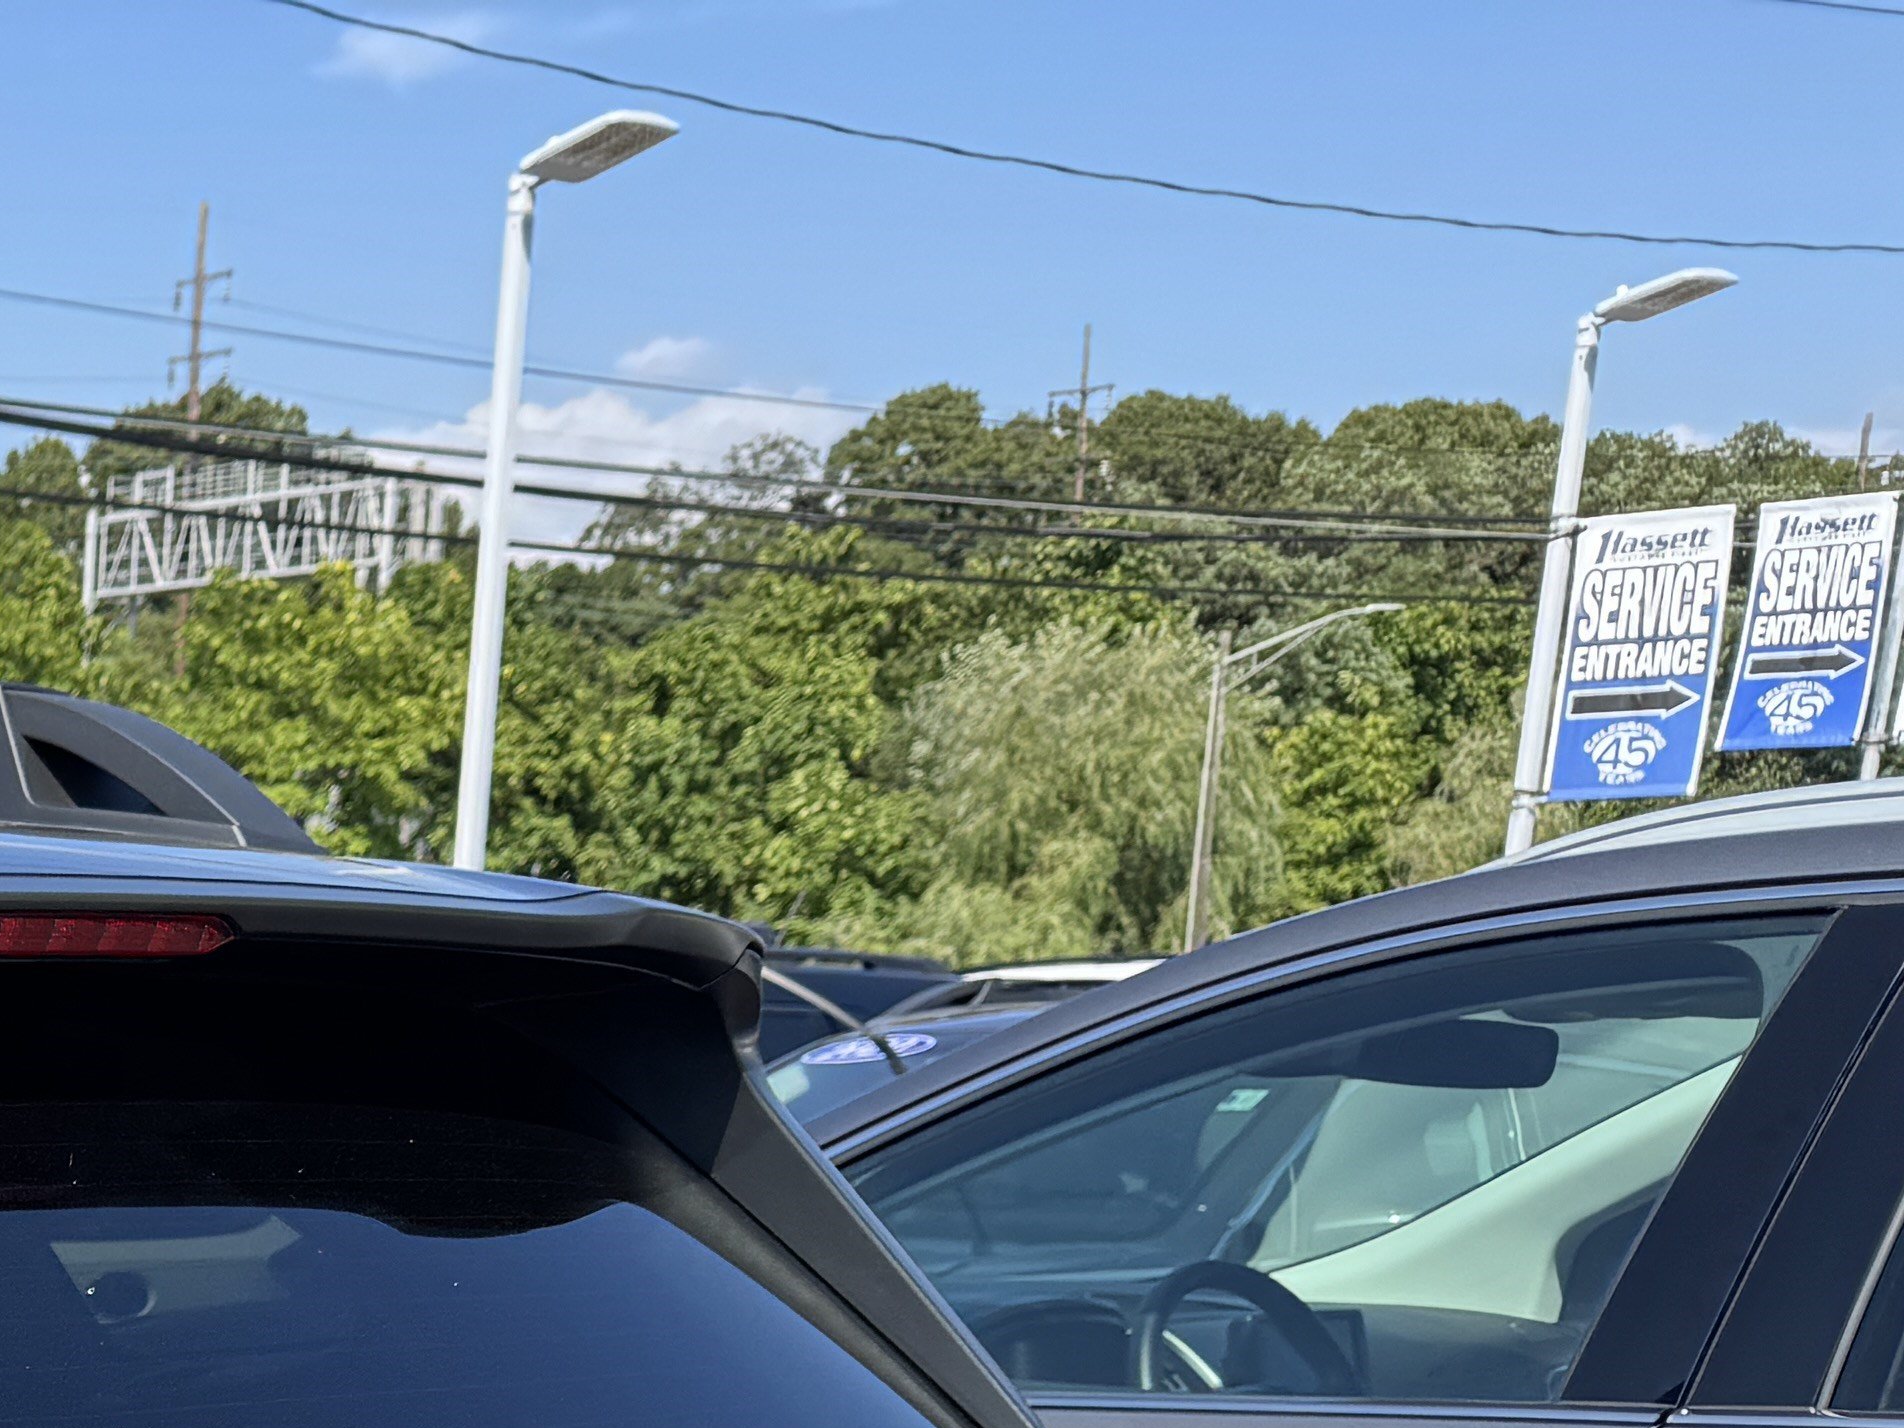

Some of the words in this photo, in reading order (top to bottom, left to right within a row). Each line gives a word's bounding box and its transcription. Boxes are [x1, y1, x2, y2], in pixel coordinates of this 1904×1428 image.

[1758, 540, 1883, 613] SERVICE
[1577, 560, 1719, 643] SERVICE
[1750, 608, 1874, 647] ENTRANCE
[1570, 637, 1710, 683] ENTRANCE
[1768, 690, 1825, 721] 45
[1594, 732, 1656, 770] 45
